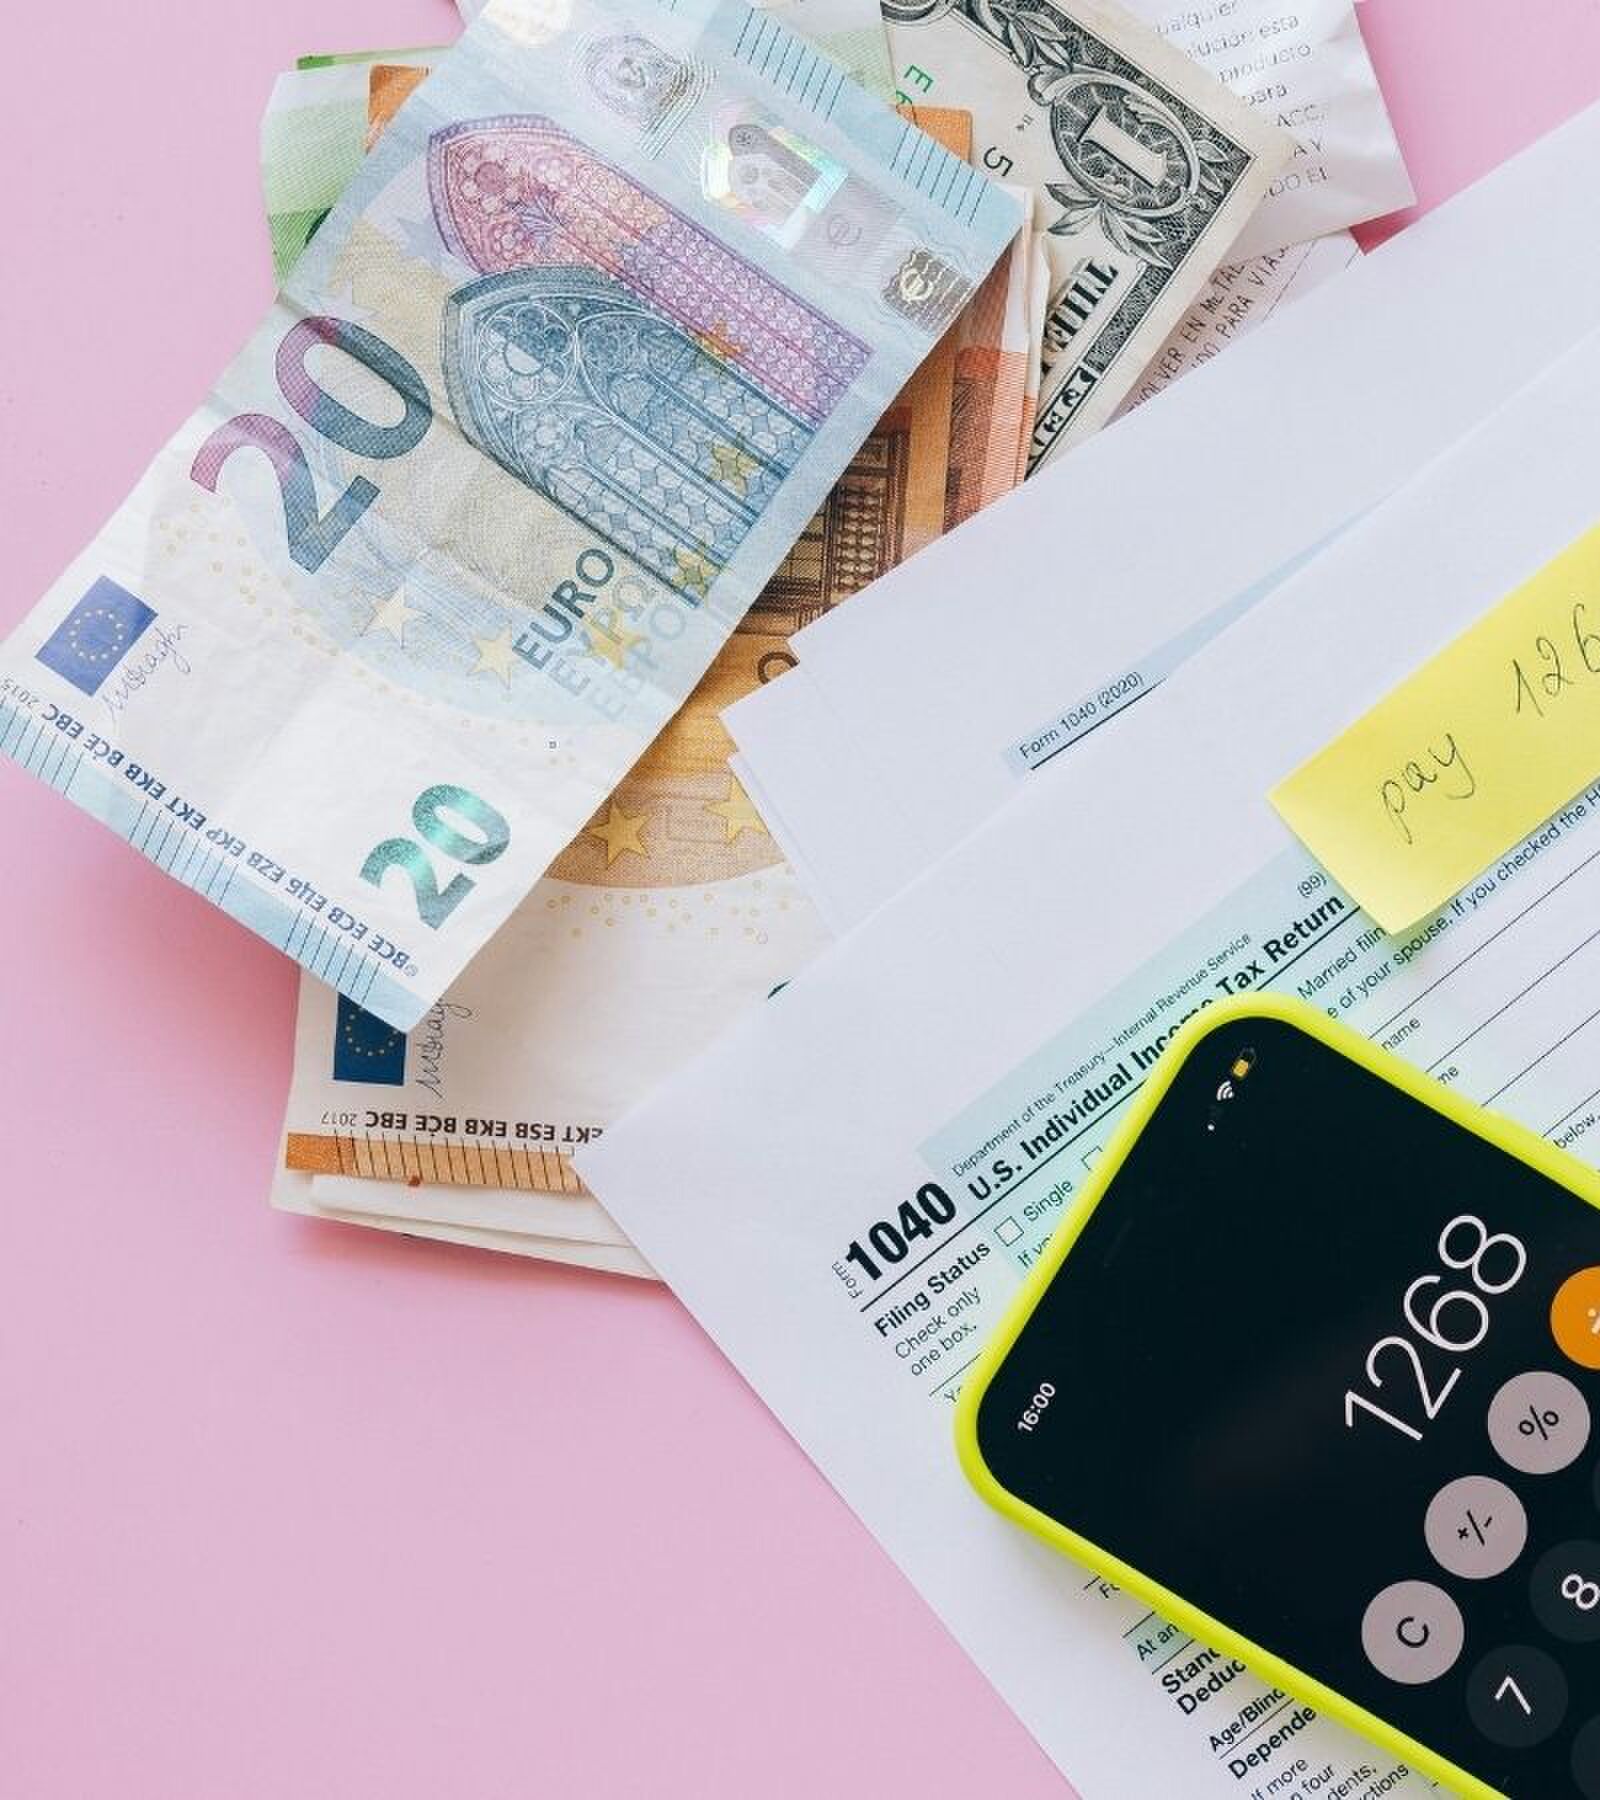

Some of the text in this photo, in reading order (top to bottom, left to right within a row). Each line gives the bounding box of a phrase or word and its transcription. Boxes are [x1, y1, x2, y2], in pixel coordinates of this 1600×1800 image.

[983, 146, 1014, 177] 5
[1078, 103, 1170, 191] 1
[190, 314, 434, 575] 20
[512, 547, 615, 671] EURO
[41, 703, 84, 741] EBC
[1019, 671, 1145, 759] Form 1040 (2020)
[125, 763, 167, 801] EKB
[1380, 732, 1476, 846] pay
[166, 795, 208, 832] EKT
[205, 826, 247, 858] EKP
[359, 783, 512, 931] 20
[246, 851, 288, 884] EZB
[1297, 871, 1328, 900] (99)
[327, 905, 369, 940] ECB
[1339, 987, 1357, 1010] of
[1354, 963, 1394, 1004] your
[1391, 916, 1452, 968] spouse.
[1450, 898, 1465, 918] If
[1465, 873, 1499, 911] you
[1495, 822, 1562, 882] checked
[1558, 803, 1587, 832] the
[1296, 948, 1358, 1002] Married
[967, 894, 1345, 1202] U.S. Individual Tax Return
[1379, 1014, 1422, 1053] name
[951, 1118, 1022, 1178] Department
[1021, 1104, 1037, 1123] of
[1033, 1089, 1056, 1112] the
[1156, 966, 1209, 1015] Revenue
[1206, 933, 1252, 973] Service
[320, 1111, 357, 1127] 2017
[365, 1110, 408, 1131] EBC
[464, 1118, 507, 1137] EKB
[515, 1122, 556, 1142] ESB
[1022, 1179, 1074, 1222] Single
[831, 1181, 957, 1300] Form 1040
[873, 1241, 992, 1338] Filing Status
[894, 1286, 981, 1360] Check only
[1344, 1214, 1527, 1441] 1268
[910, 1324, 978, 1377] one box.
[1015, 1381, 1058, 1435] 16:00
[1518, 1405, 1560, 1441] %
[1560, 1573, 1600, 1611] 8
[1135, 1638, 1158, 1662] At
[1396, 1615, 1430, 1649] C
[1494, 1675, 1533, 1717] 7
[1226, 1704, 1318, 1781] Depende
[1265, 1758, 1310, 1794] more
[1302, 1764, 1335, 1796] four
